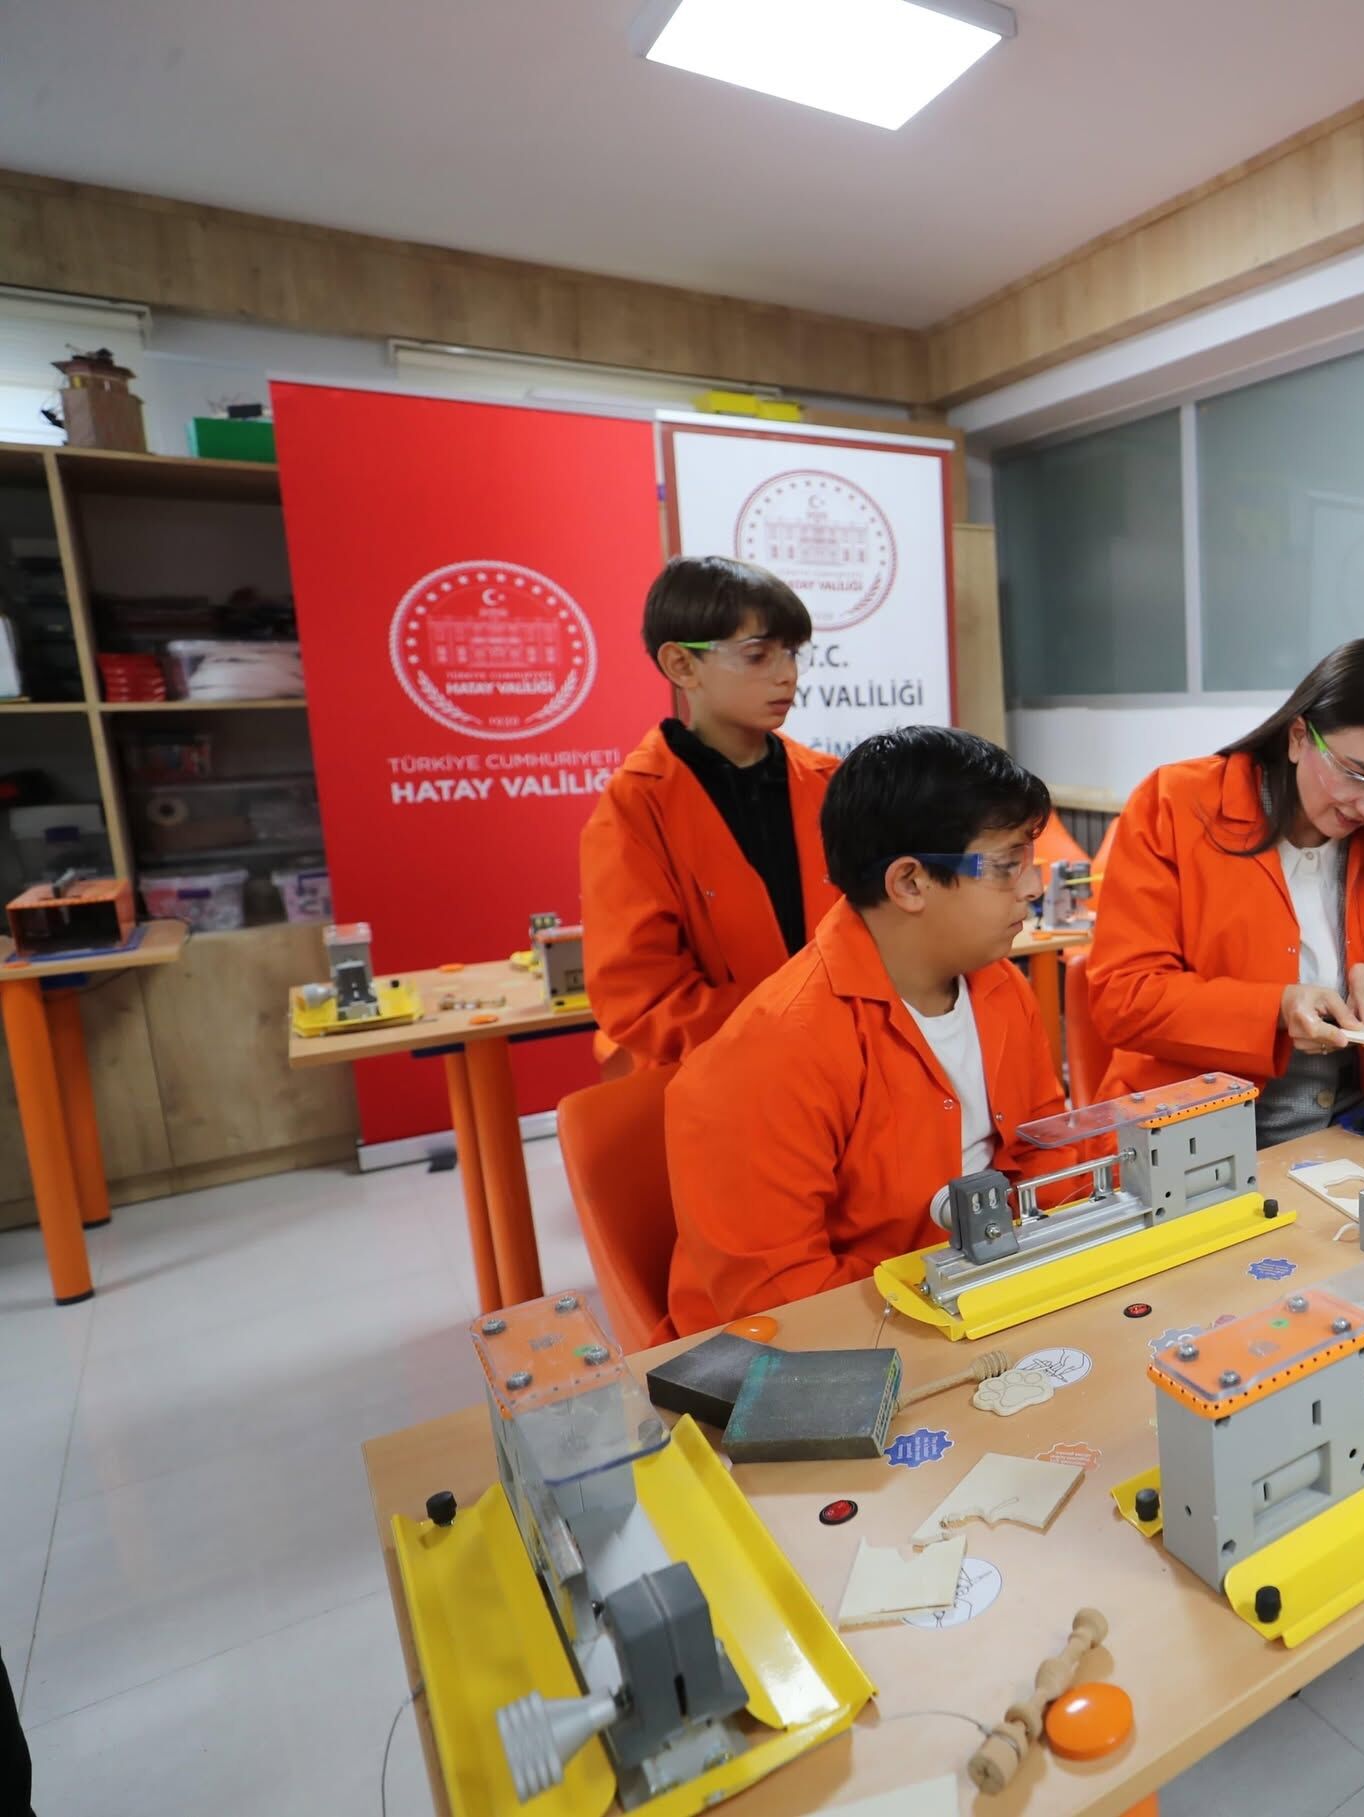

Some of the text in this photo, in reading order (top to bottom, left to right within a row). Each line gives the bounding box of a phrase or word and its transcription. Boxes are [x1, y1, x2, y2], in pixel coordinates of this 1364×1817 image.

[819, 679, 924, 707] VALİLİĞİ
[387, 748, 621, 774] TÜRKİYE CUMHURİYETİ
[390, 767, 619, 804] HATAY VALİLİĞ
